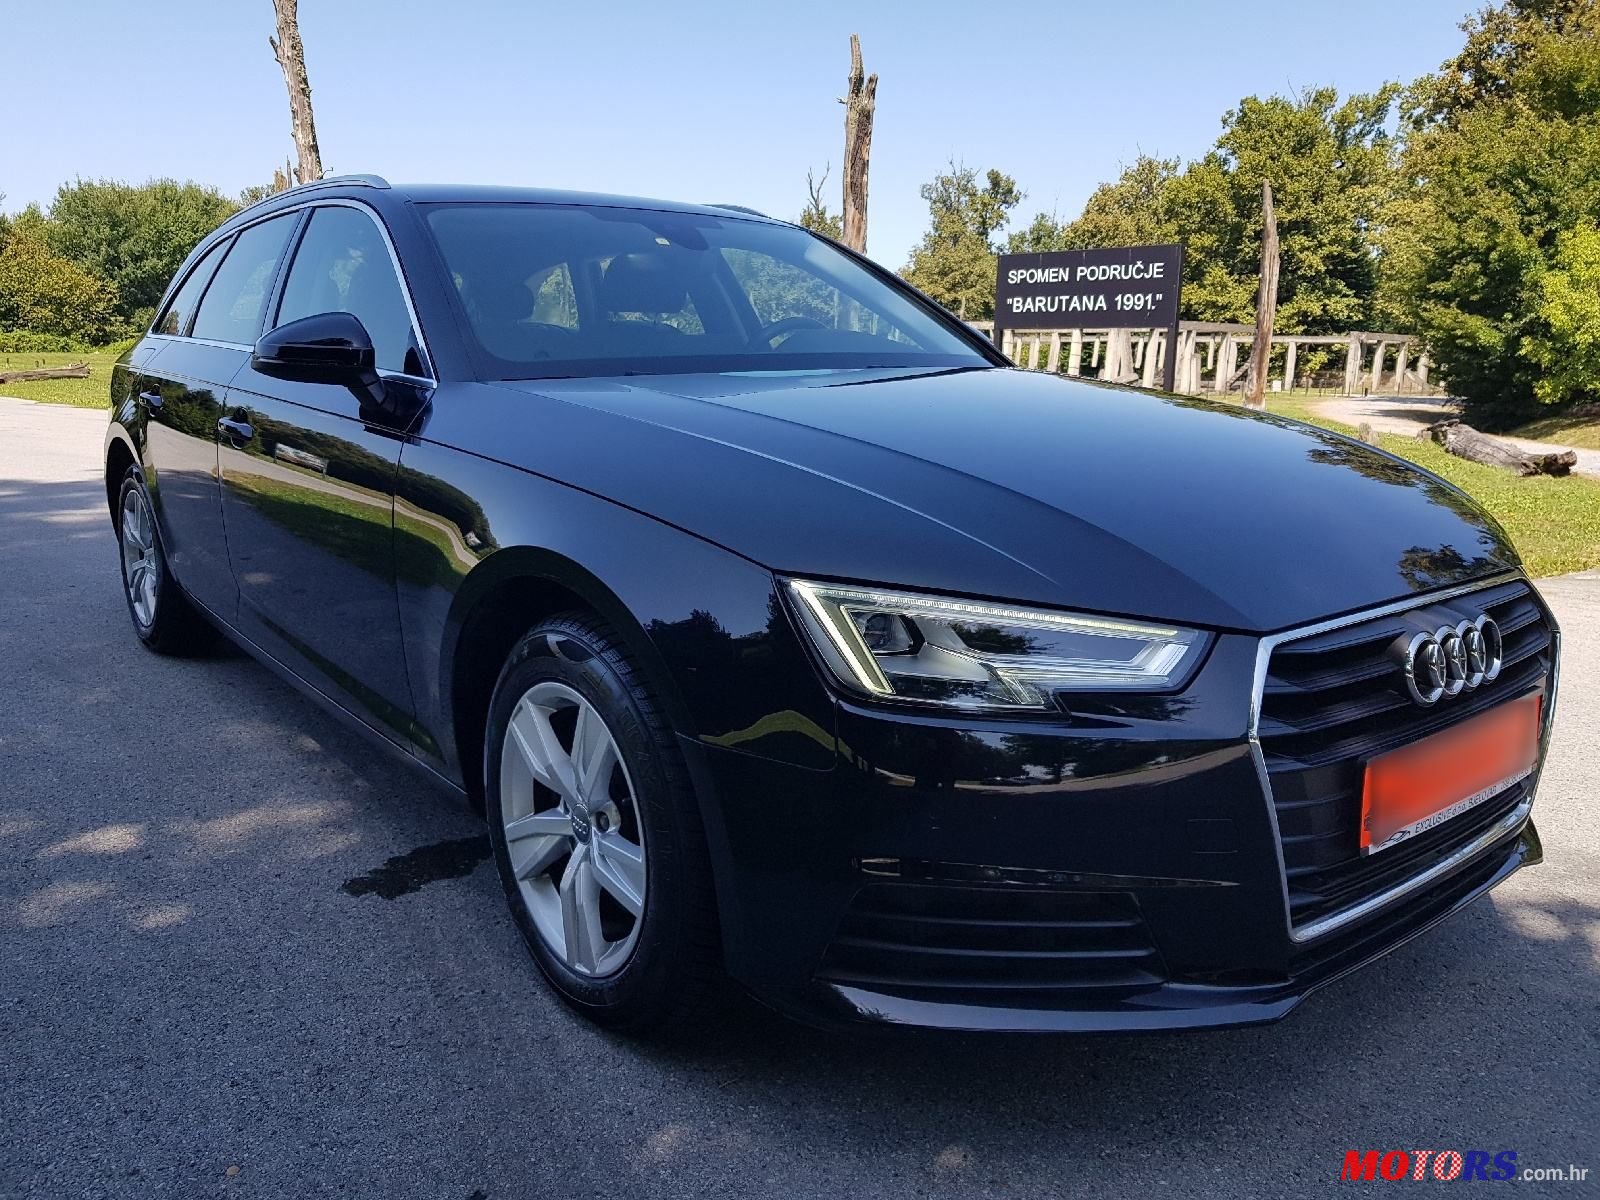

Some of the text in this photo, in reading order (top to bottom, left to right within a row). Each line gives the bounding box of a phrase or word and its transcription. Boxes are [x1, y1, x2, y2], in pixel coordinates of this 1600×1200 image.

[1007, 260, 1165, 285] SPOMEN PODRUČJE
[1007, 295, 1107, 313] "BARUTANA
[1415, 808, 1453, 834] EXCLUSIVE
